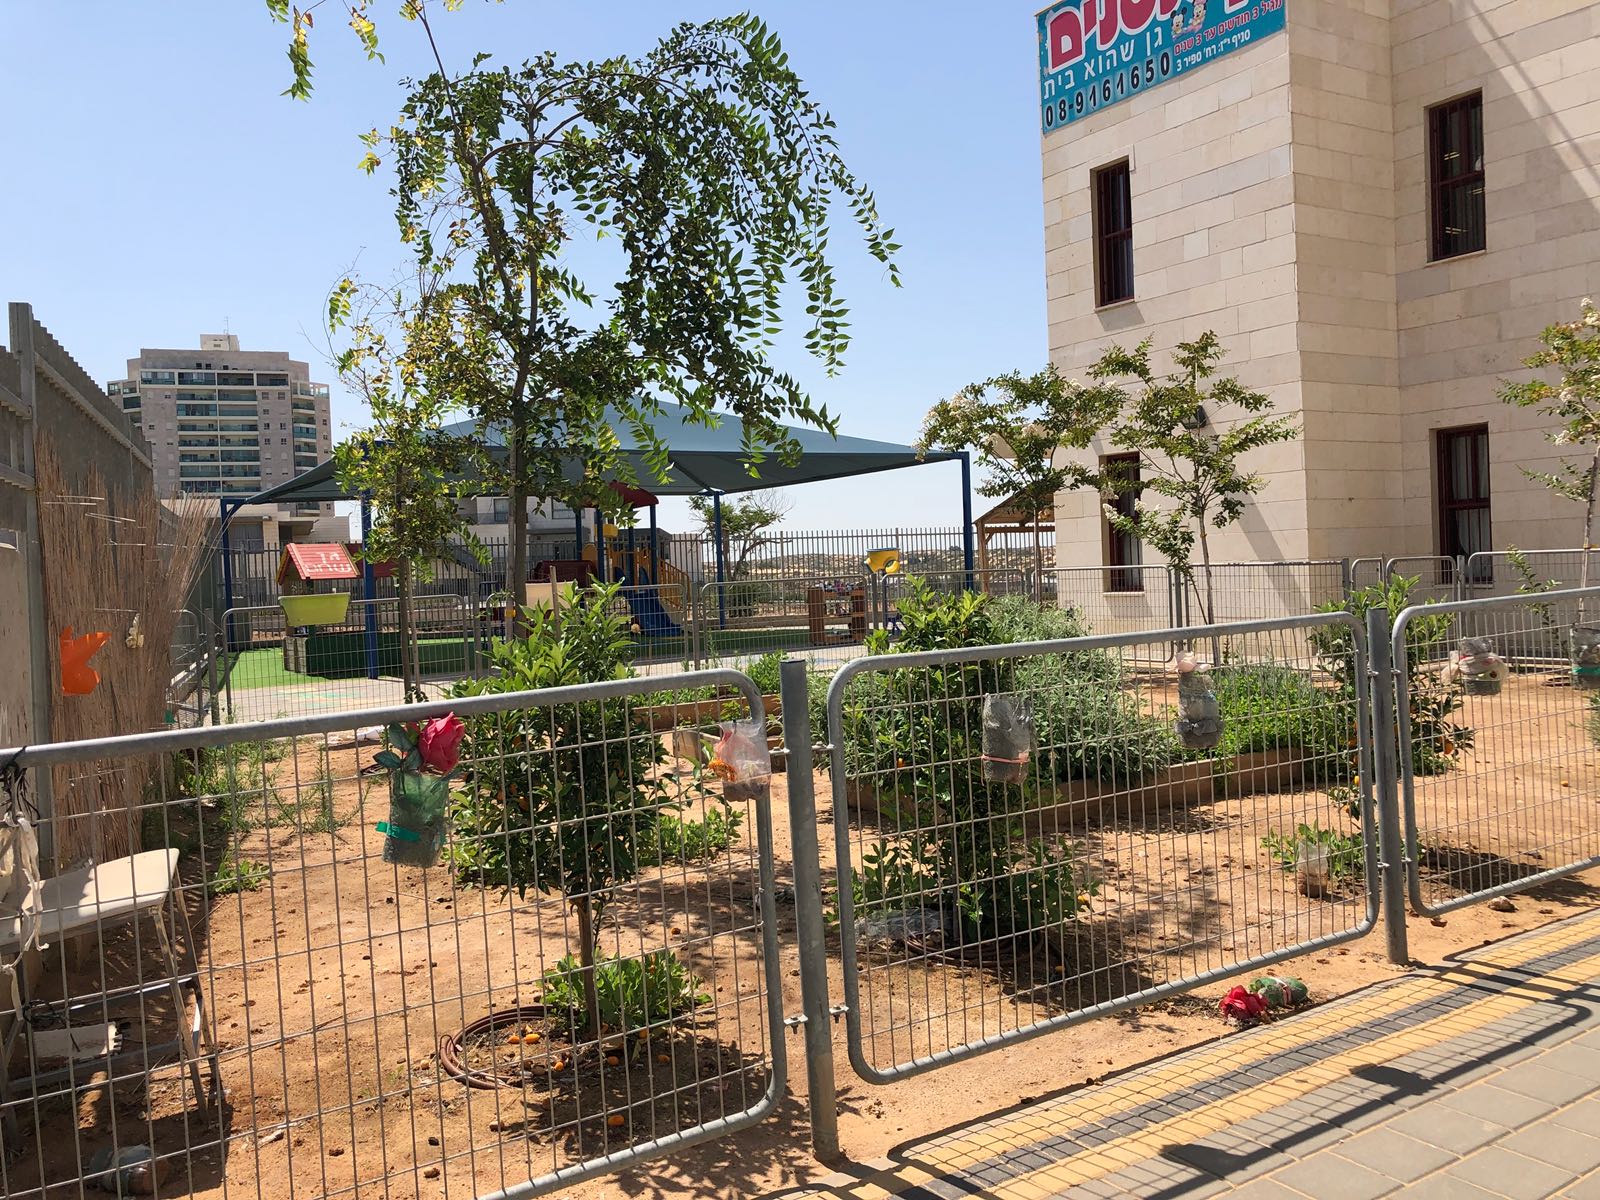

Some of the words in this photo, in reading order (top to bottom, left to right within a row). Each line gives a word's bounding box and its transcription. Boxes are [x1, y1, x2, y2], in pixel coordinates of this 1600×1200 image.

[1218, 11, 1250, 35] חודשים
[1252, 7, 1259, 20] 3
[1146, 26, 1163, 56] גן
[1195, 33, 1202, 46] 3
[1204, 27, 1217, 41] עד
[1232, 29, 1251, 48] סניף
[1173, 37, 1194, 56] שנים
[1084, 39, 1135, 80] שהוא
[1176, 59, 1182, 72] 3
[1184, 51, 1202, 67] ספיר
[1044, 69, 1075, 99] בית
[1046, 52, 1171, 127] 08-9161650
